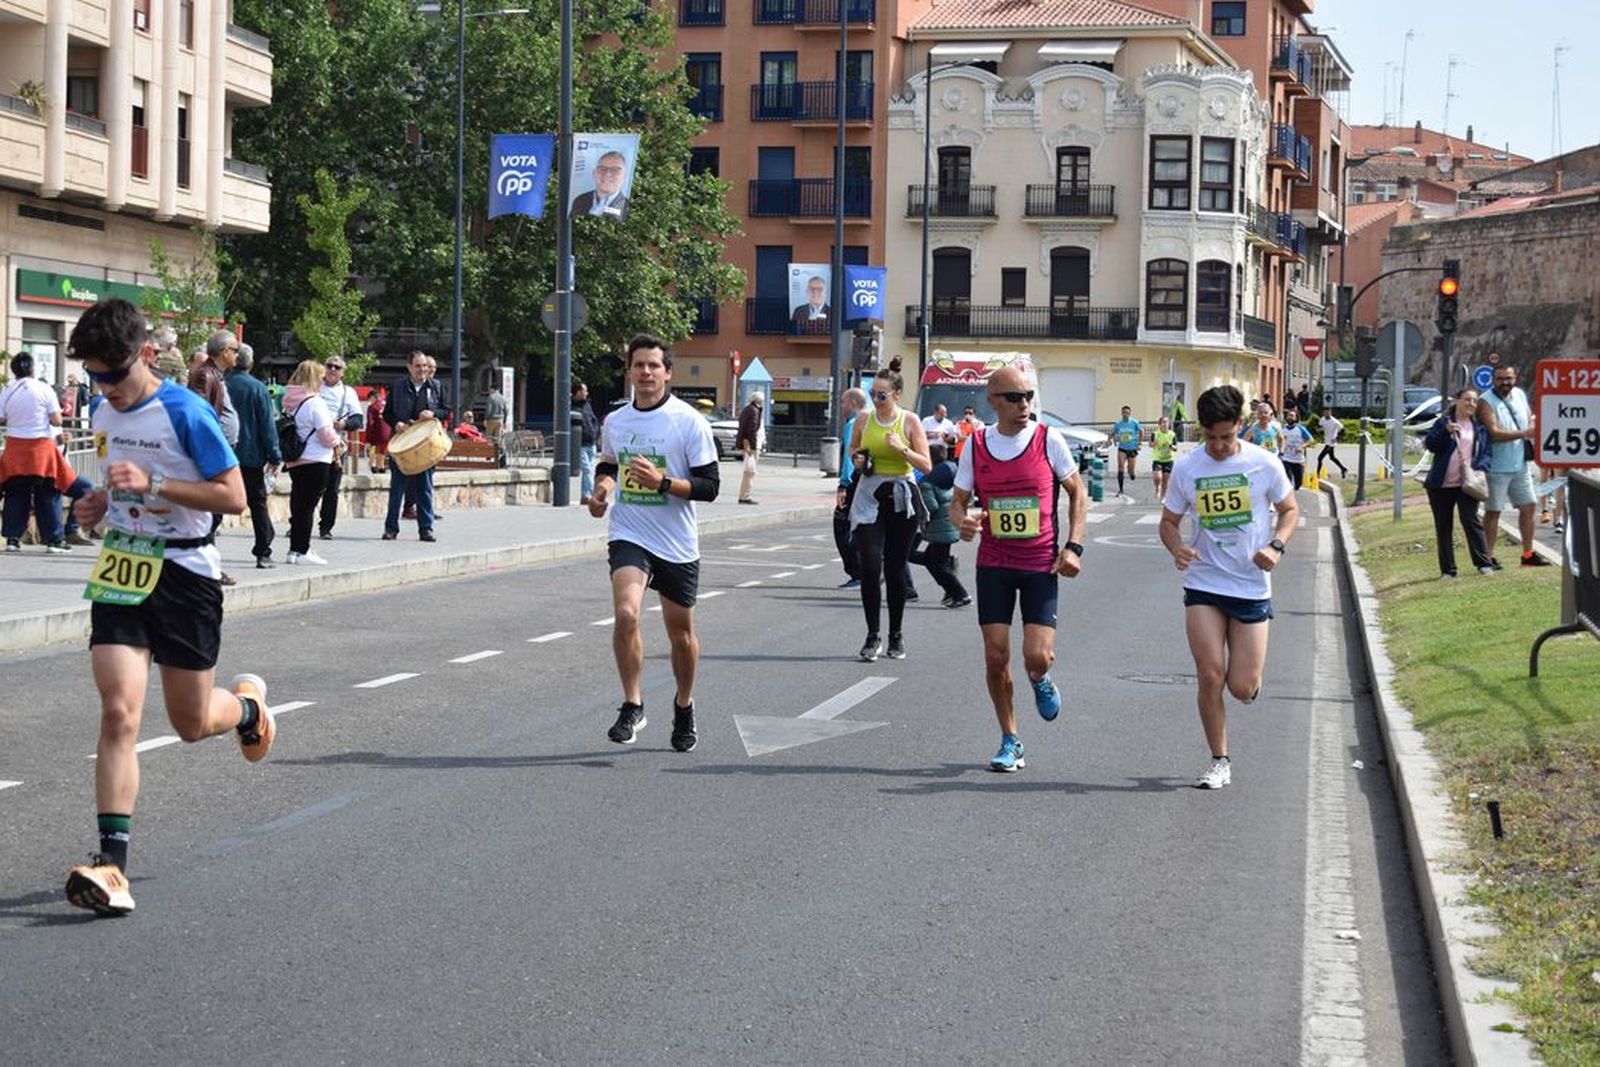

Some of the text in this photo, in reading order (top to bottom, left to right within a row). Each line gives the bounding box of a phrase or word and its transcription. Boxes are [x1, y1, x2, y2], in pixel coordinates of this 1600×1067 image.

[500, 155, 538, 167] VOTA
[852, 279, 878, 289] VOTA
[1543, 368, 1600, 389] N-122
[1559, 402, 1586, 418] km
[1543, 427, 1600, 455] 459
[1201, 490, 1242, 513] 155
[1000, 513, 1027, 533] 89
[99, 554, 153, 588] 200
